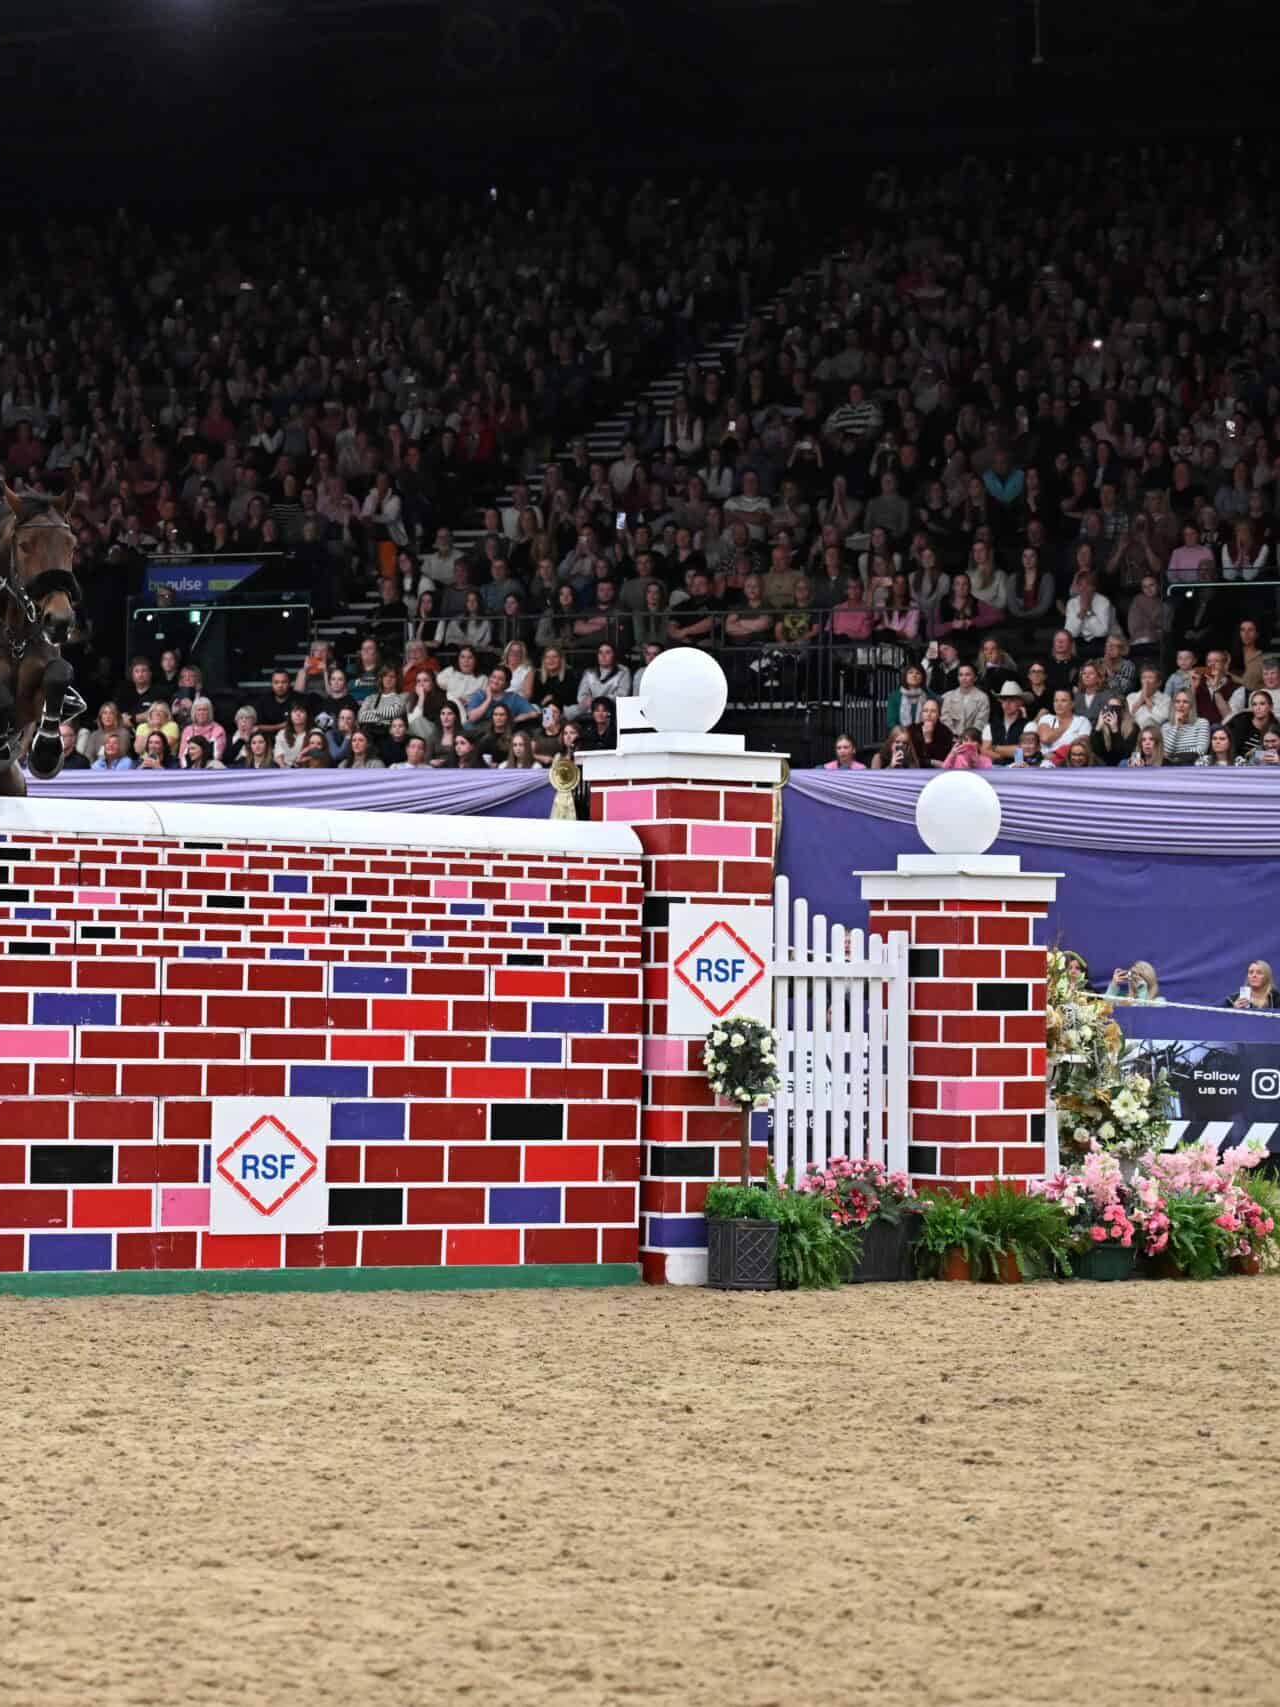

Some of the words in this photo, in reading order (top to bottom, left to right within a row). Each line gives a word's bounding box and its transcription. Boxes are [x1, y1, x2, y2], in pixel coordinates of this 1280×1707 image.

[696, 958, 745, 983] RSF
[1193, 1070, 1241, 1081] Follow
[1198, 1086, 1216, 1095] us
[1218, 1086, 1238, 1095] on
[241, 1154, 296, 1180] RSF
